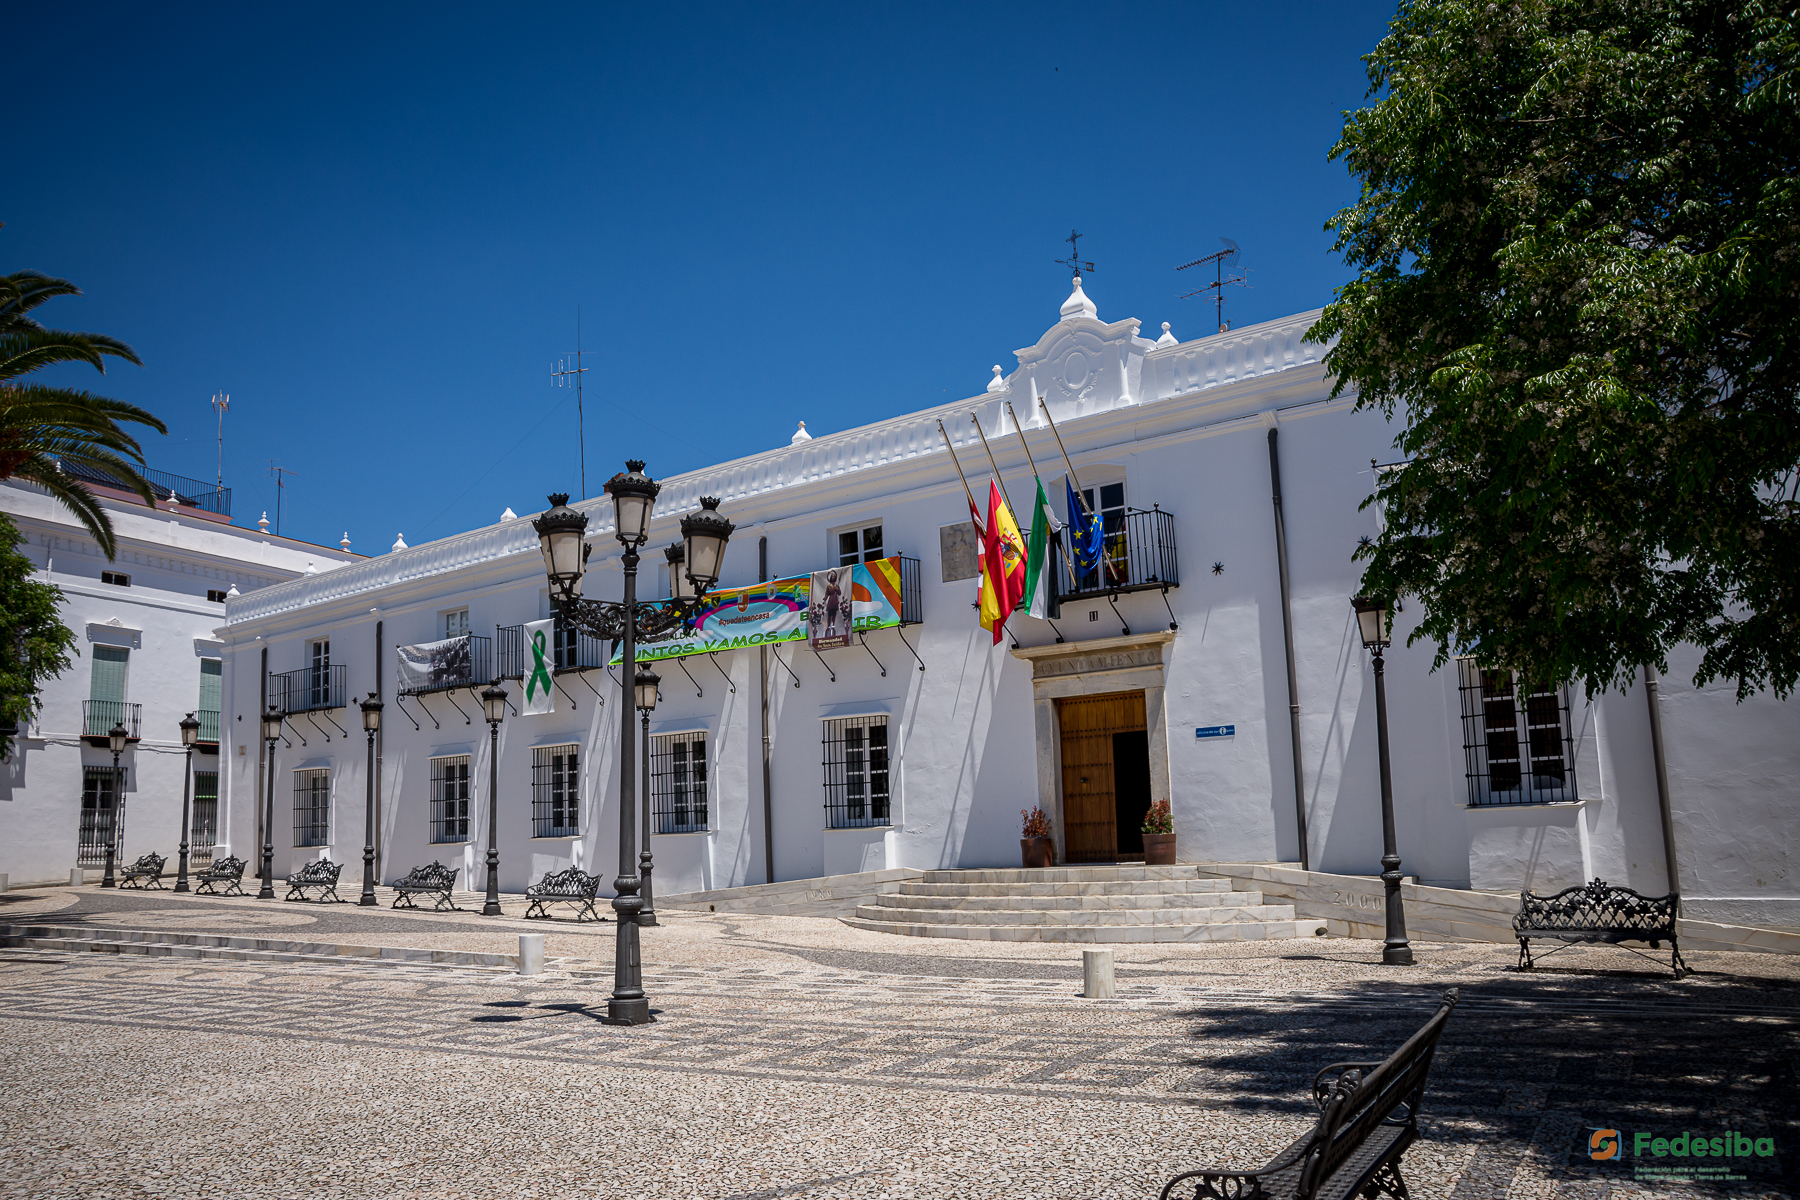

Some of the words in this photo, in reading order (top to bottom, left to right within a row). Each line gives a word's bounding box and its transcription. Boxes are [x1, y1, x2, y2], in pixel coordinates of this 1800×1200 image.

[718, 612, 770, 627] #quedateencasa
[617, 643, 695, 661] UNTOS
[704, 631, 778, 651] VAMOS
[788, 627, 802, 639] A
[1333, 892, 1381, 910] 2000
